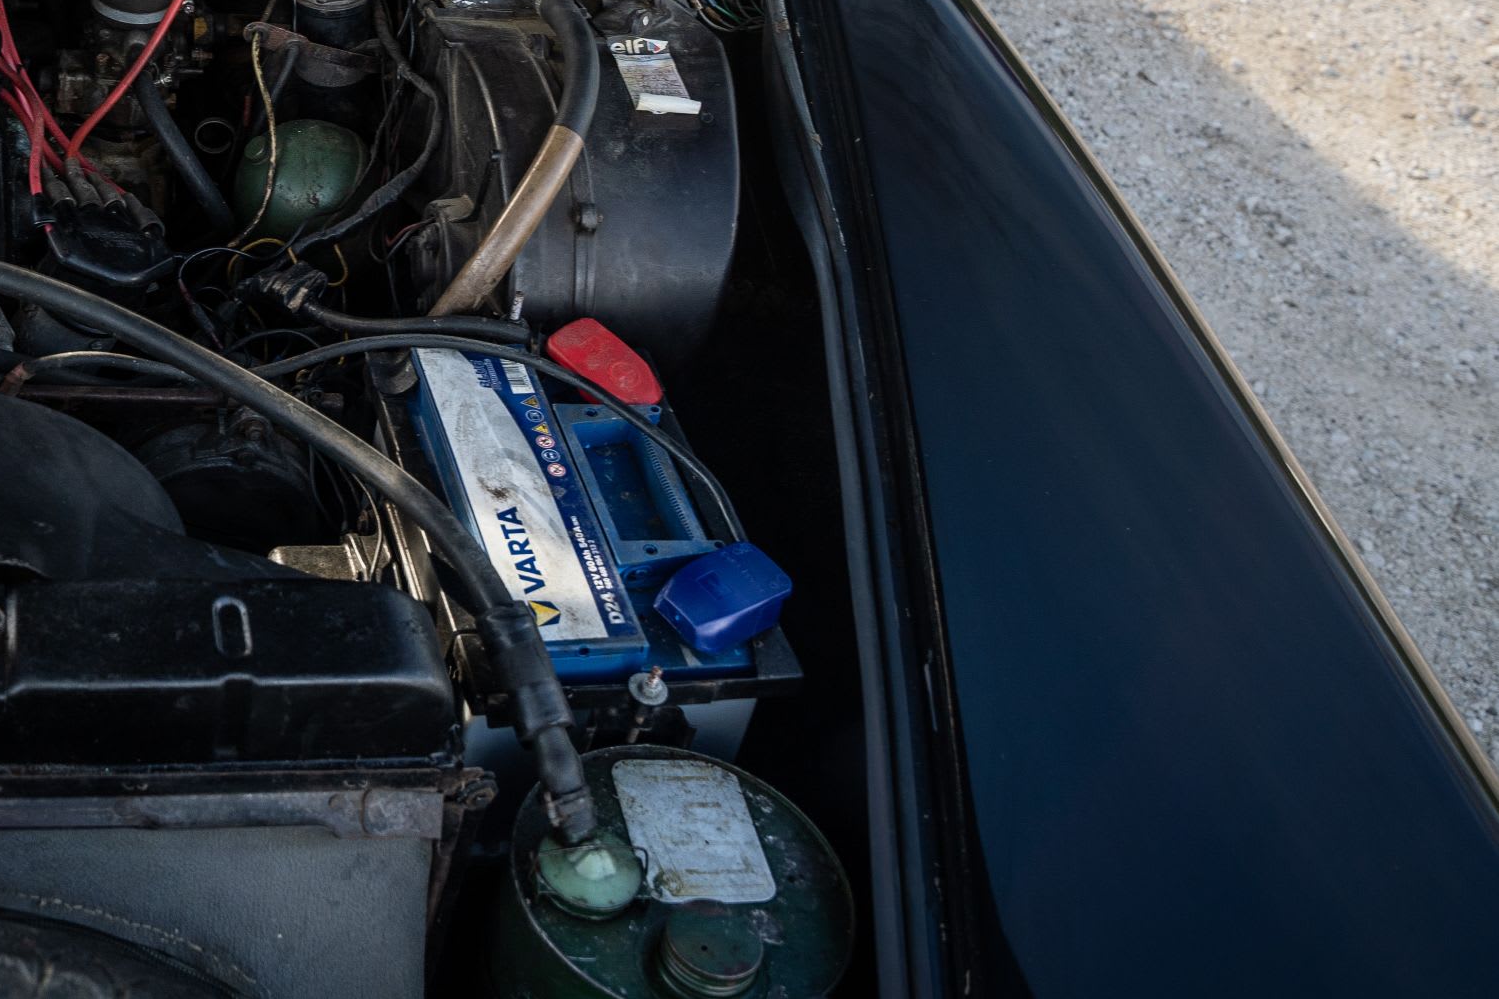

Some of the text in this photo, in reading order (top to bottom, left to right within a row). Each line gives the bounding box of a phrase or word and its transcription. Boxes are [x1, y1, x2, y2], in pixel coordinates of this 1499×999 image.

[610, 38, 645, 54] elf
[496, 506, 546, 595] VARTA
[590, 573, 605, 590] 12V
[600, 592, 626, 625] D24
